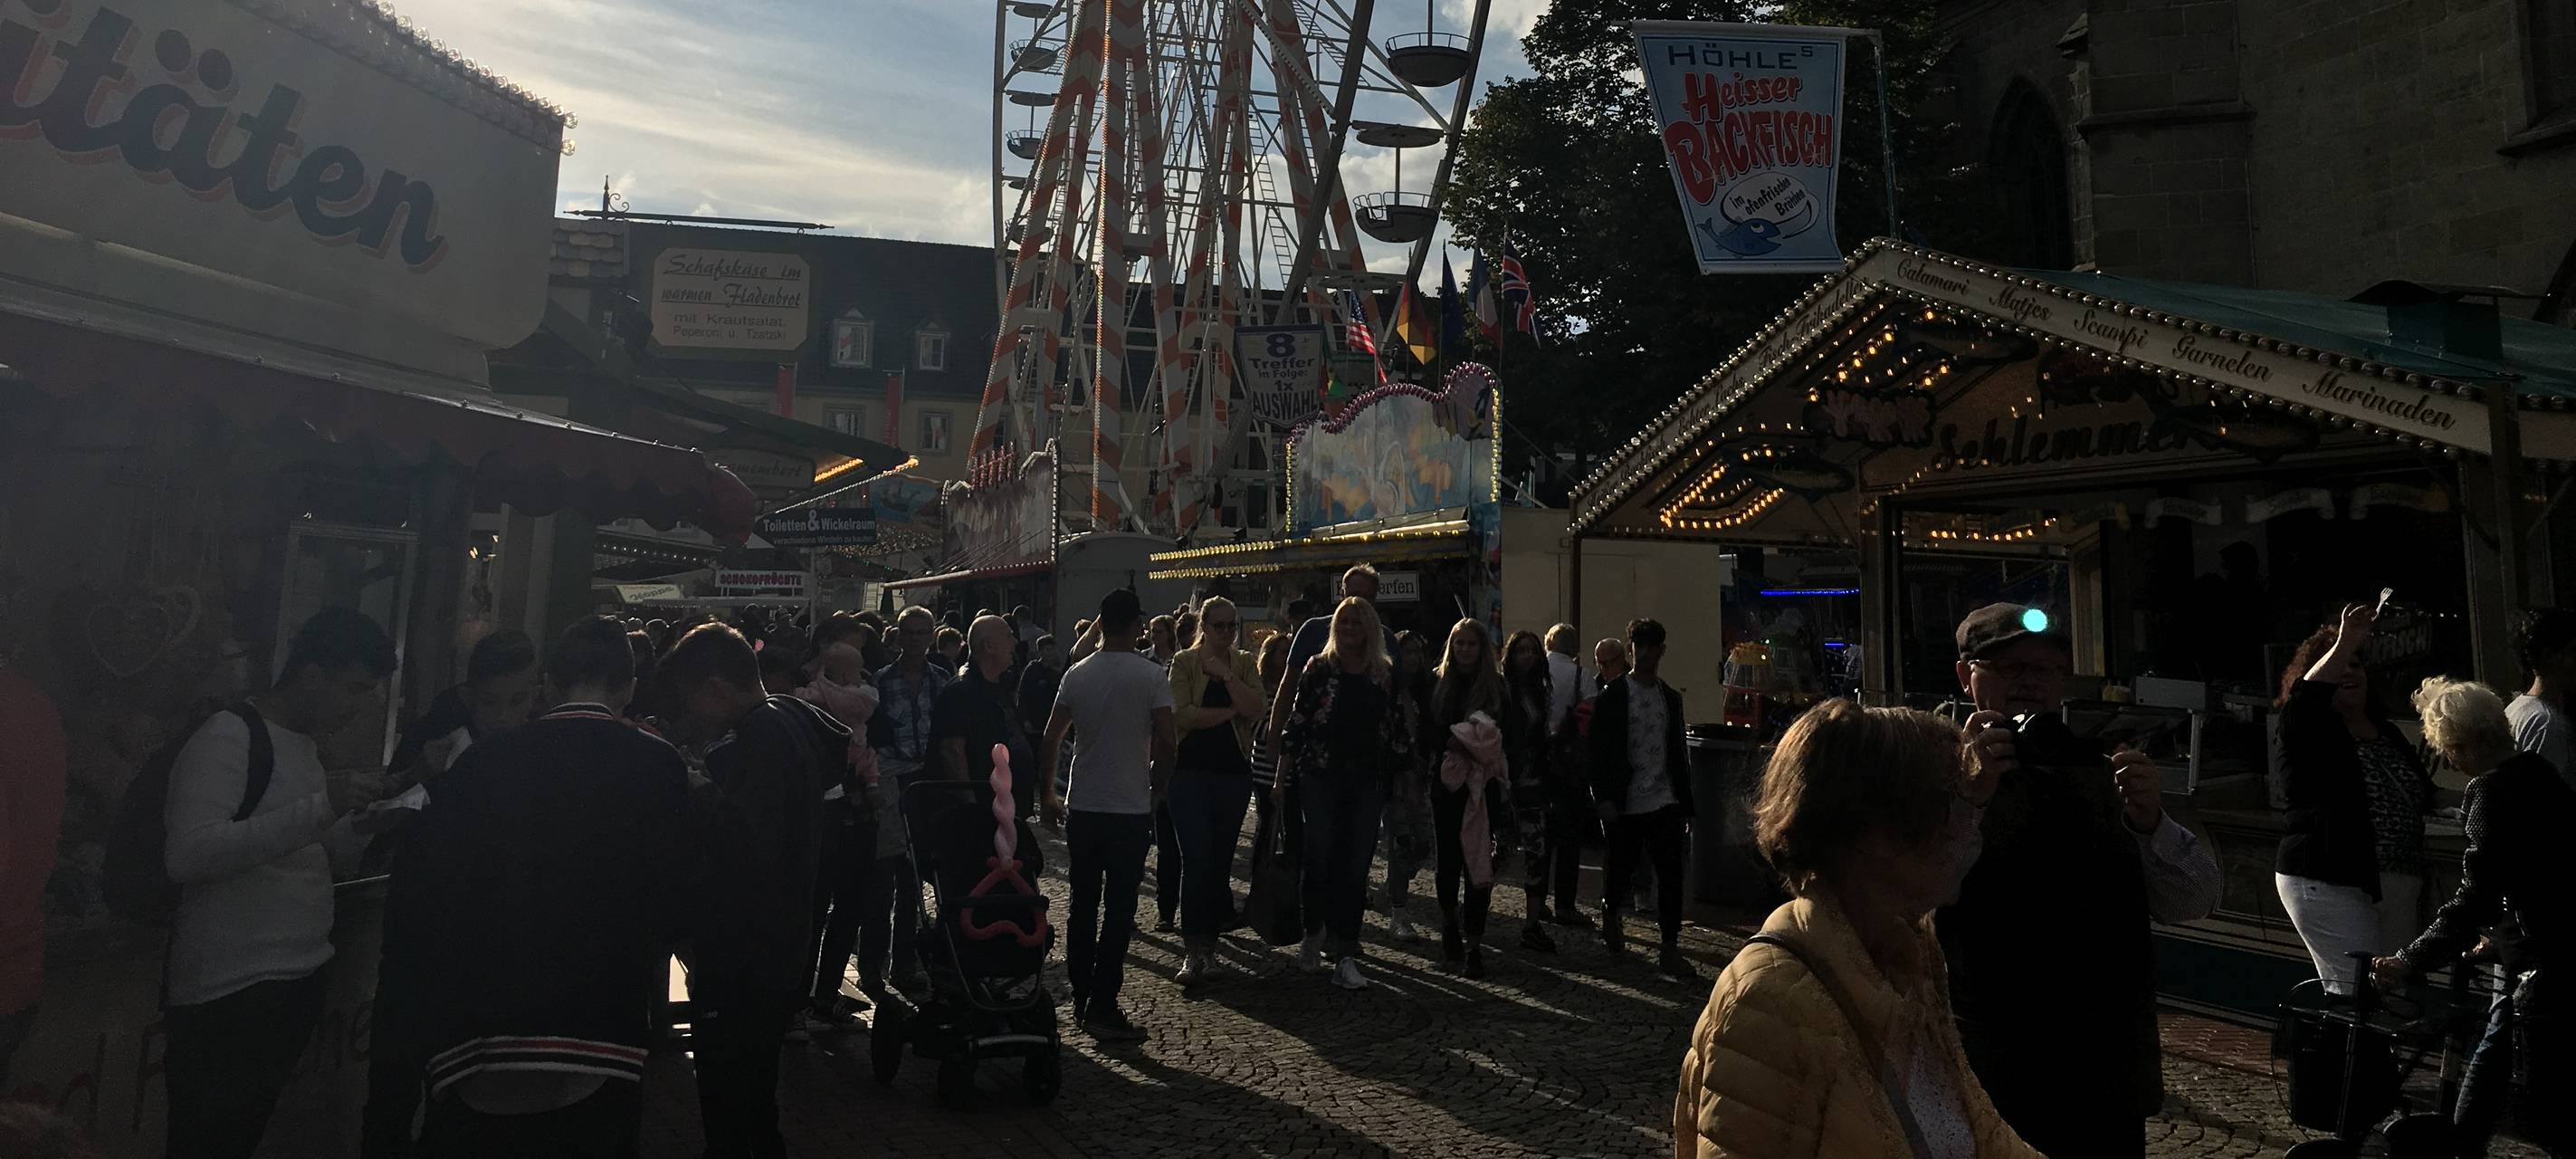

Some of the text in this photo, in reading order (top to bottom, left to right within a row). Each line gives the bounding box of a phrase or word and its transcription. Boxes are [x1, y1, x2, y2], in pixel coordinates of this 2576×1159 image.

[1681, 72, 1802, 124] Heisser
[1664, 109, 1834, 206] BACKFISCH
[1729, 194, 1744, 210] im
[1744, 177, 1792, 216] ofenfrischen
[1774, 188, 1807, 216] Brötchen
[663, 254, 801, 282] Schafskäse im
[661, 283, 802, 309] warmen Fladenbrot
[673, 312, 698, 323] mit
[745, 328, 787, 341] Tzatziki
[1266, 333, 1295, 358] 8
[1897, 257, 1970, 297] Calamari
[1988, 285, 2052, 321] Matjes
[2073, 309, 2151, 353] Scampi
[2171, 332, 2275, 383] Garnelen
[2302, 369, 2457, 432] Marinaden
[1248, 357, 1315, 369] Treffer
[1259, 368, 1308, 380] in Folge:
[1274, 380, 1294, 391] 1x
[1252, 389, 1318, 421] AUSWAHL
[762, 509, 875, 532] Toiletten & Wickelraum
[720, 572, 802, 586] SCHOKOFRÜCHTE
